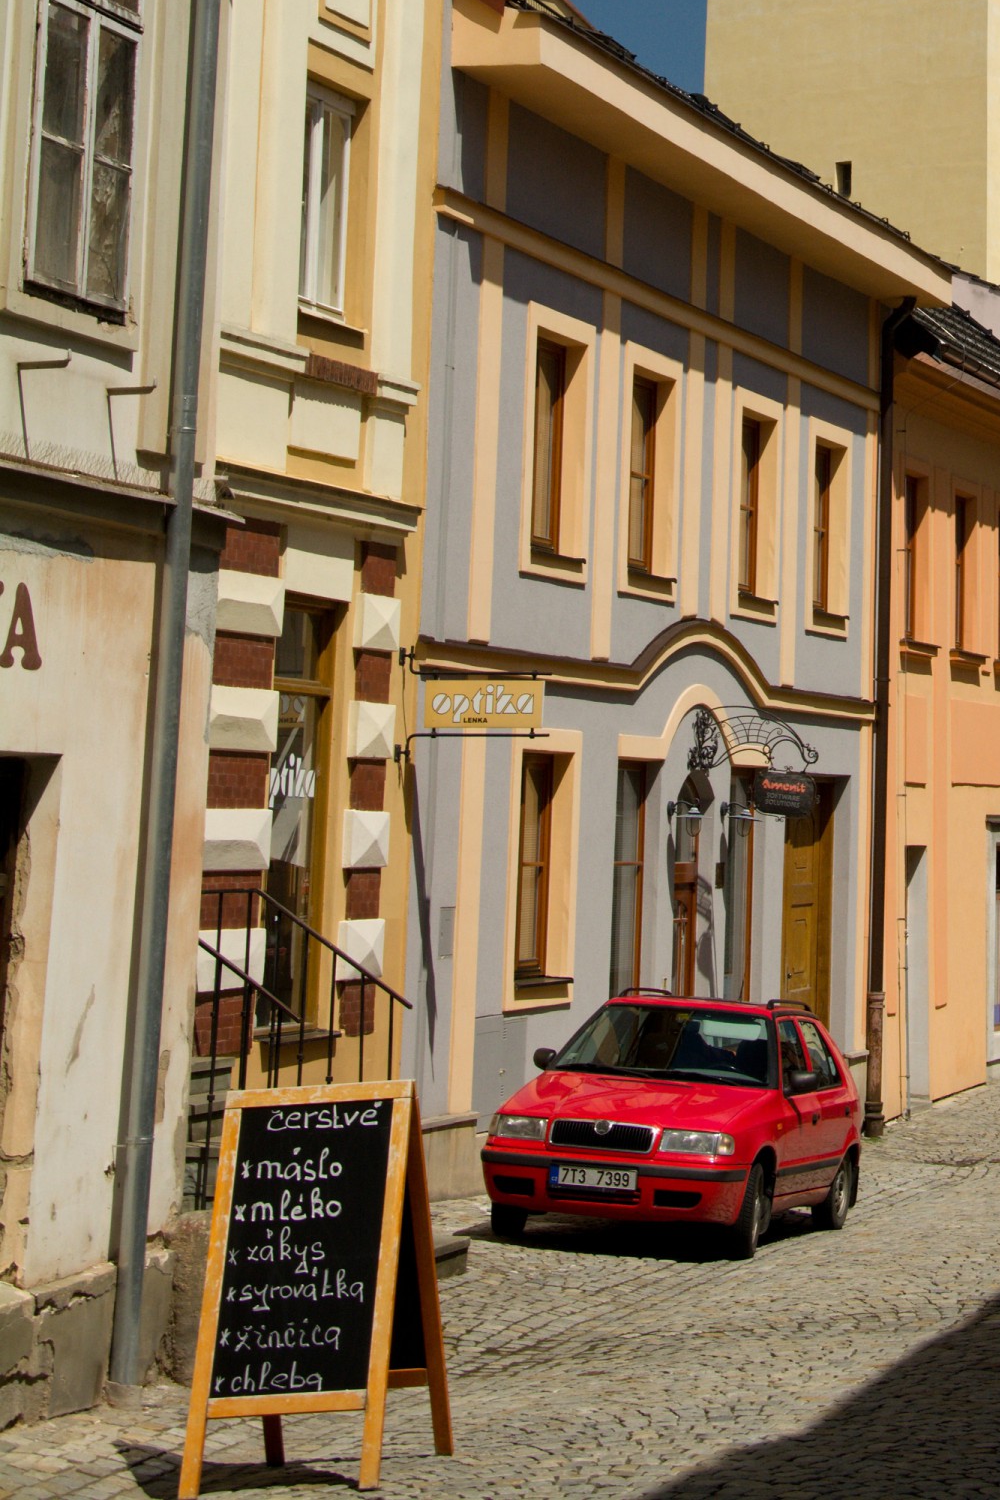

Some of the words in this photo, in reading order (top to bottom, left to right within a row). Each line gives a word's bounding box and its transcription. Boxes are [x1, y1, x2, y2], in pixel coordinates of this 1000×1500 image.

[431, 683, 535, 723] optika
[268, 752, 316, 808] ptika
[762, 778, 806, 793] Amenit
[767, 793, 800, 801] SOFTWARE
[765, 800, 800, 808] SOLUTIONS
[266, 1100, 383, 1132] čerstvé
[256, 1146, 343, 1182] máslo
[561, 1168, 586, 1184] 7T3
[596, 1170, 630, 1188] 7399
[250, 1186, 343, 1222] mléko
[247, 1225, 326, 1274] zákys
[238, 1265, 364, 1312] syrovátka
[230, 1360, 324, 1393] chleba
